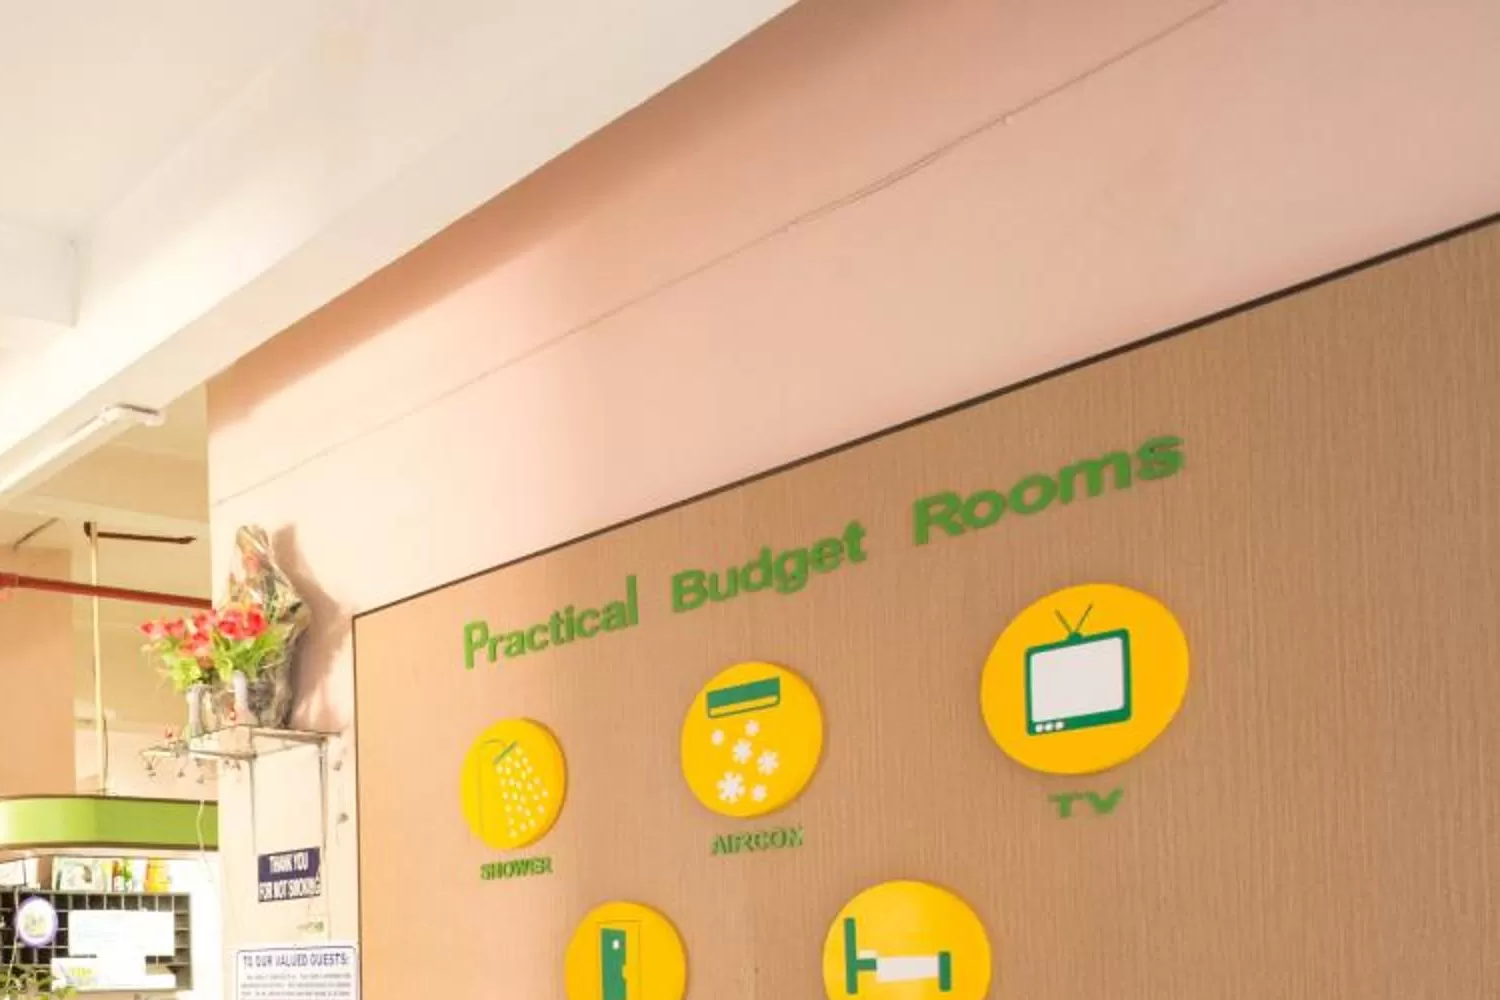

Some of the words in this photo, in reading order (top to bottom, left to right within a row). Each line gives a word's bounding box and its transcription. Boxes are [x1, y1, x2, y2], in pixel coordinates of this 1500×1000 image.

[463, 575, 639, 669] Practical
[672, 520, 866, 612] Budget
[913, 434, 1186, 545] Rooms
[1047, 789, 1124, 818] TV
[711, 827, 804, 855] AIRCON
[293, 851, 309, 871] YOU
[480, 857, 553, 880] SHOWER
[243, 955, 253, 968] TO
[255, 954, 273, 967] OUR
[275, 953, 309, 967] VALUED
